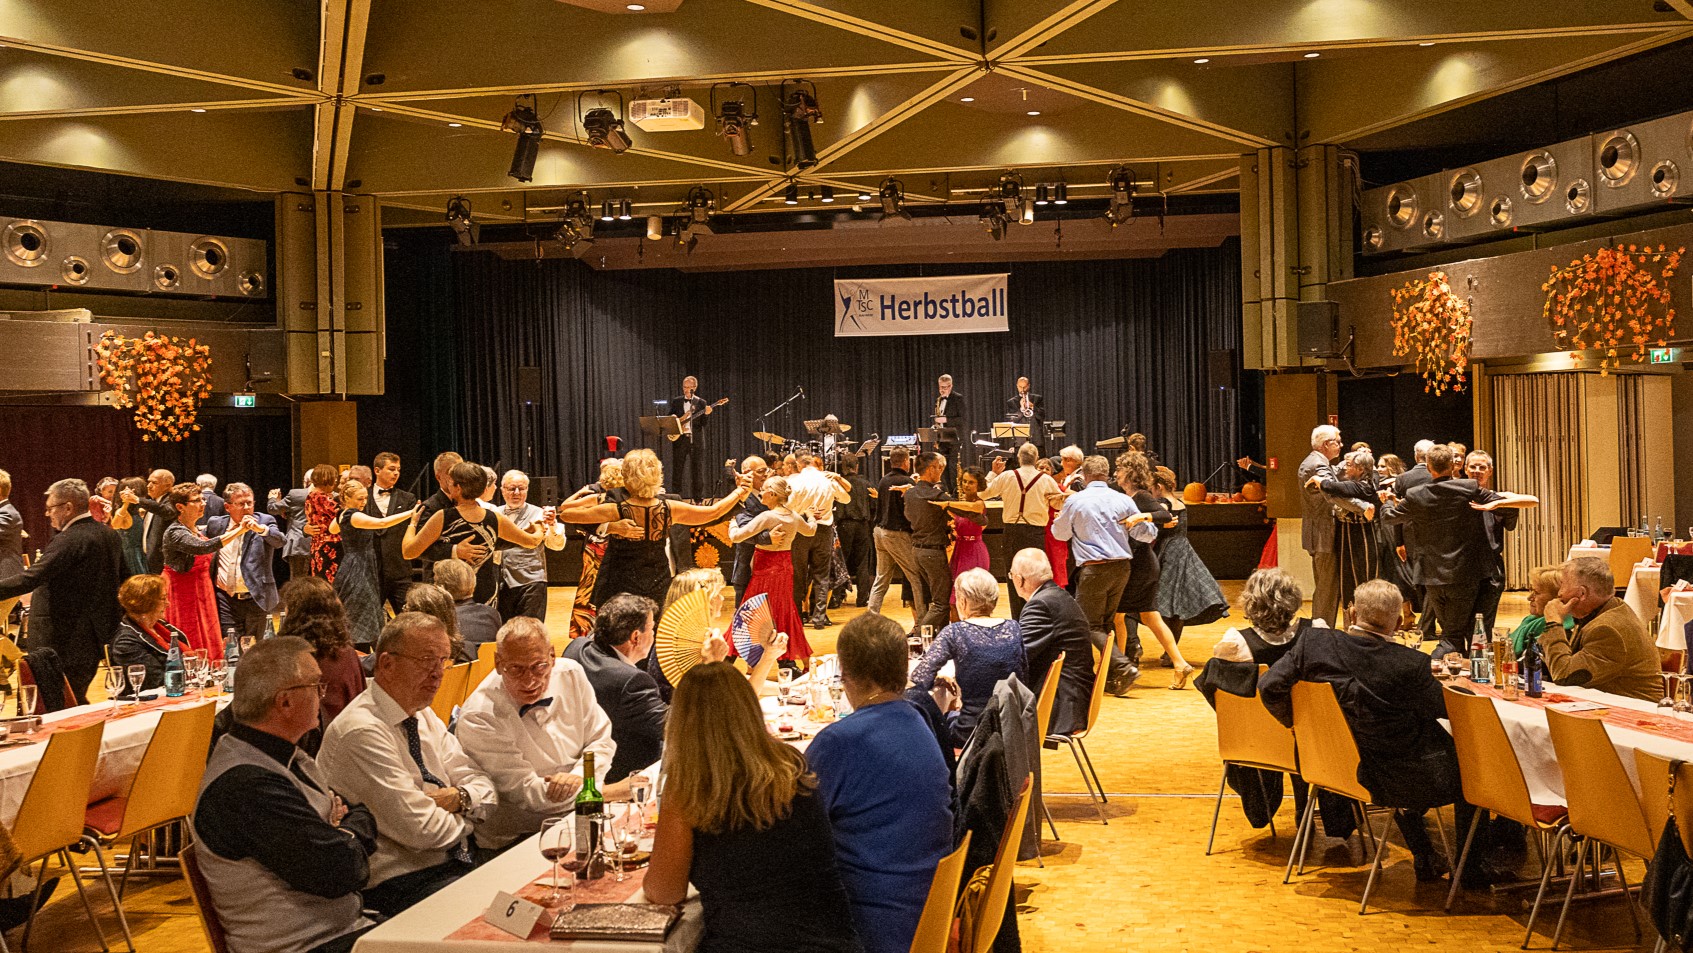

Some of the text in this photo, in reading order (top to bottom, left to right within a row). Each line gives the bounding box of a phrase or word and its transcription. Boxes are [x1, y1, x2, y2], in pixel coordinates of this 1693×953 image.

[859, 289, 869, 300] M
[856, 299, 874, 313] TSC
[880, 288, 1004, 321] Herbstball
[506, 900, 519, 917] 6
